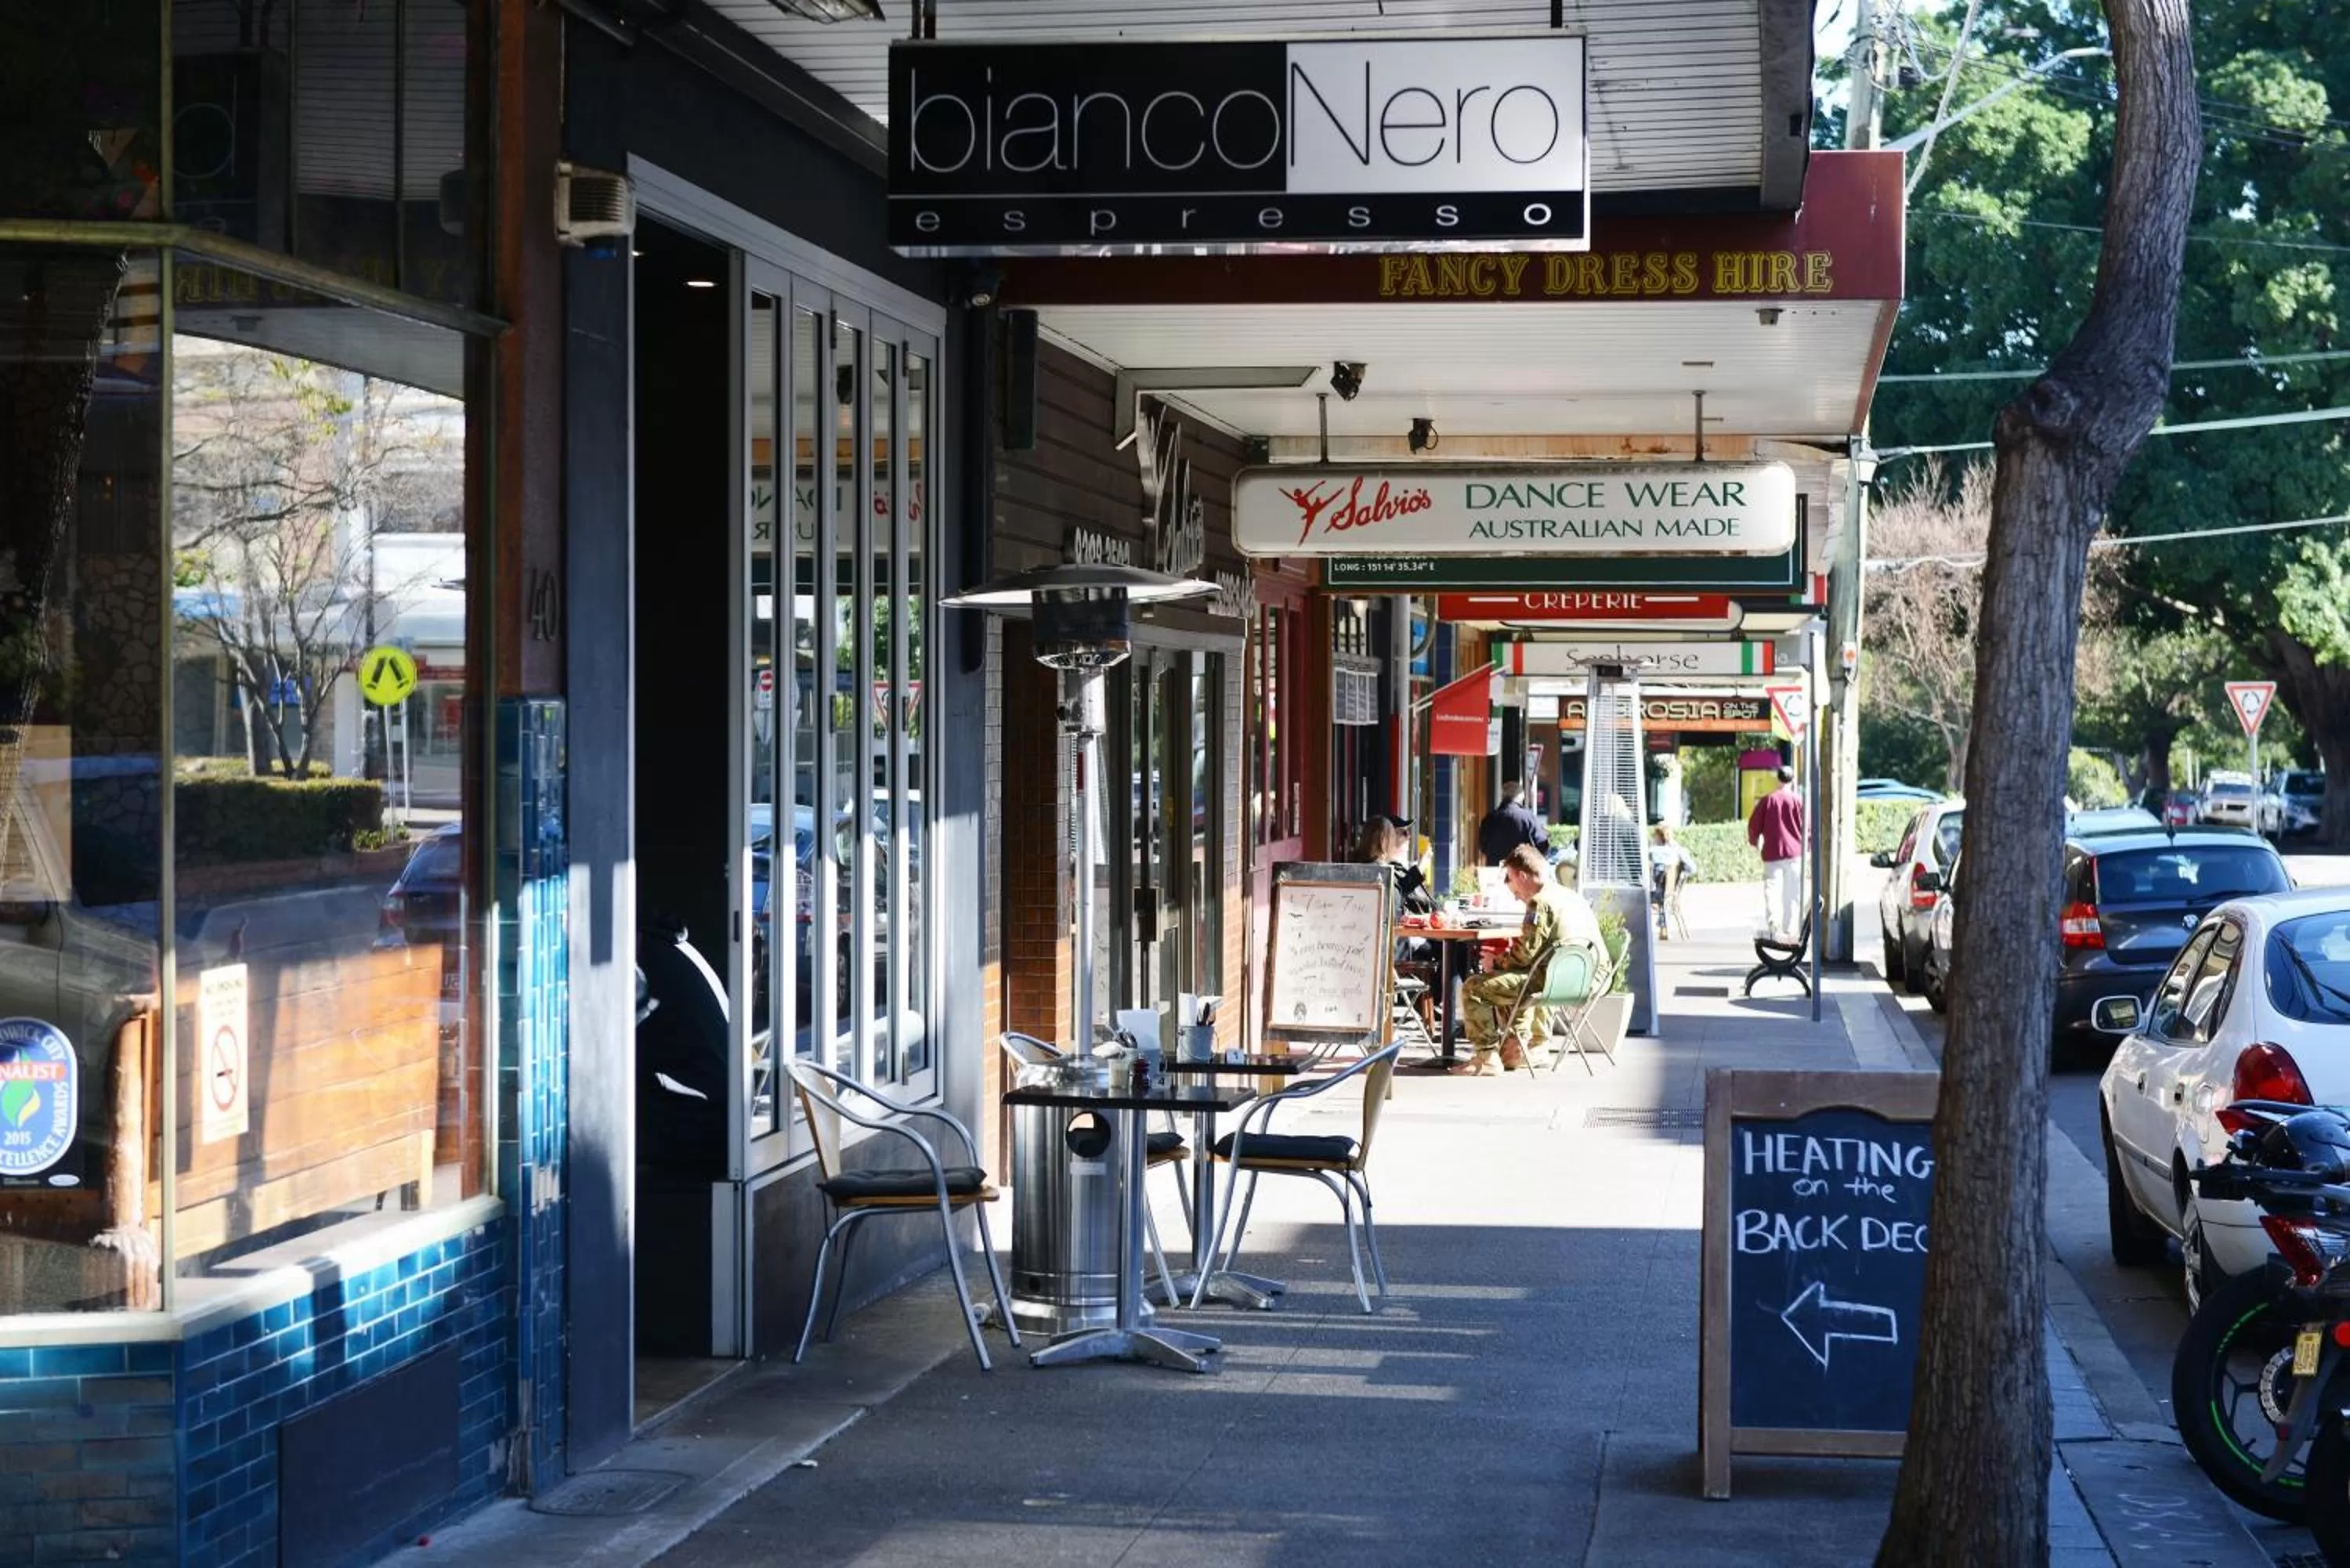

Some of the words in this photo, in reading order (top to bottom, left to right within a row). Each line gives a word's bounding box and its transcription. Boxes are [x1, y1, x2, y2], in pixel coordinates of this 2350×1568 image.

[915, 202, 1553, 236] espresso
[1379, 251, 1531, 296] FANCY
[1542, 251, 1700, 295] DRESS
[1711, 251, 1835, 294] HIRE
[1323, 475, 1433, 533] Salvio's
[1466, 482, 1605, 509] DANCE
[1624, 482, 1747, 508] WEAR
[1469, 518, 1643, 539] AUSTRALIAN
[1654, 518, 1741, 537] MADE
[526, 567, 558, 642] 40
[1567, 645, 1699, 671] Shorse
[1567, 701, 1720, 721] ABROSIA
[3, 1130, 32, 1147] 2015
[1744, 1130, 1935, 1179] HEATING
[1792, 1178, 1828, 1196] on
[1843, 1176, 1897, 1204] the
[1736, 1209, 1849, 1253] BACK
